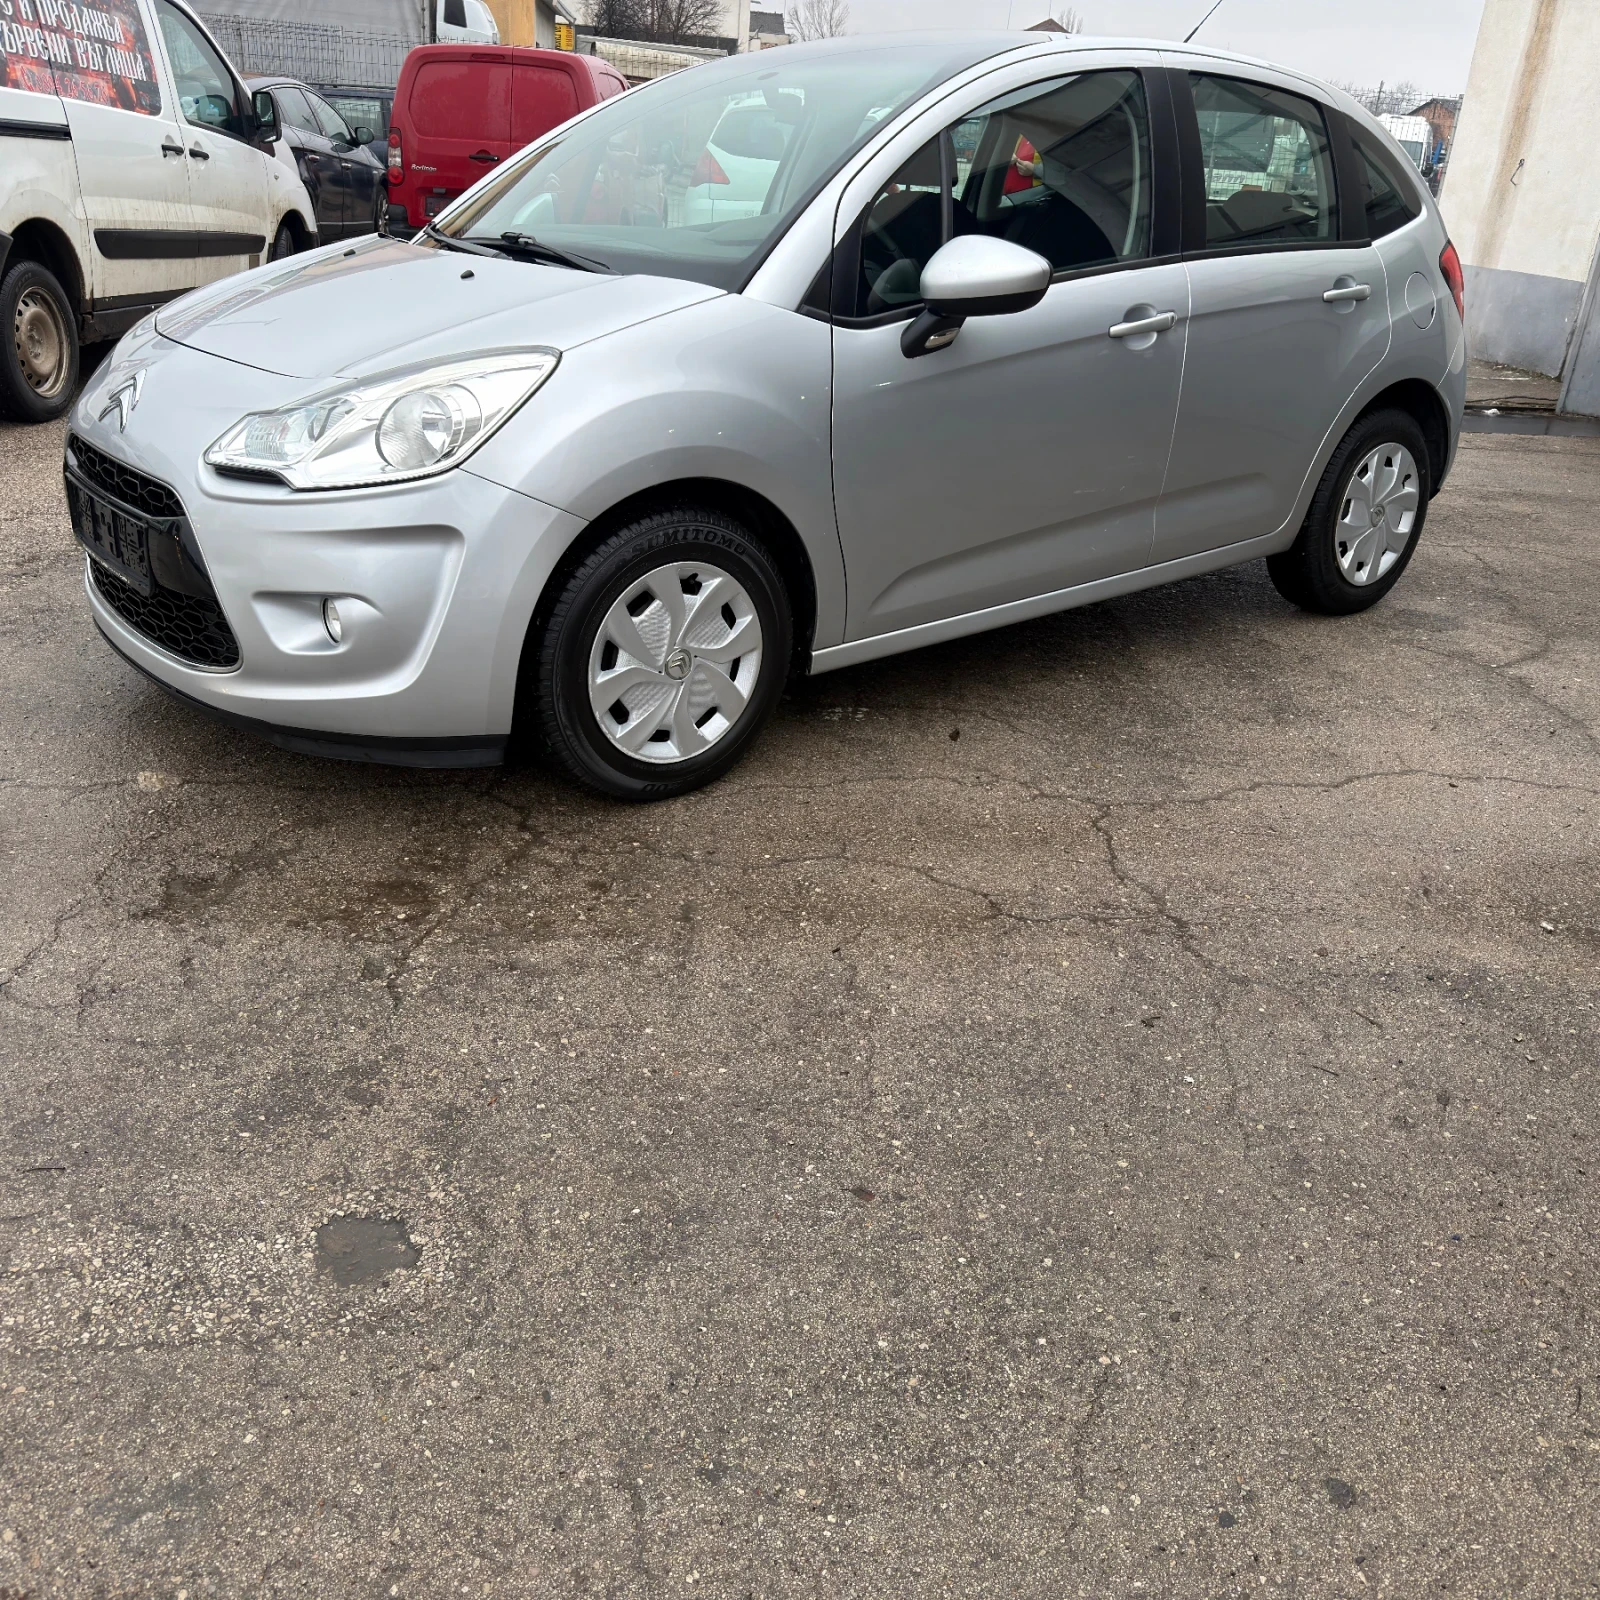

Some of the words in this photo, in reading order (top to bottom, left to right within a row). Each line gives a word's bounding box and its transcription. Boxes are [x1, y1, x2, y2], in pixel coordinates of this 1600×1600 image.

[36, 0, 125, 44] ПРОДАЖБА
[0, 20, 72, 65] ЪРВЕНИ
[74, 37, 147, 85] ВЪГЛИЩА
[631, 528, 748, 556] SUMITOMO
